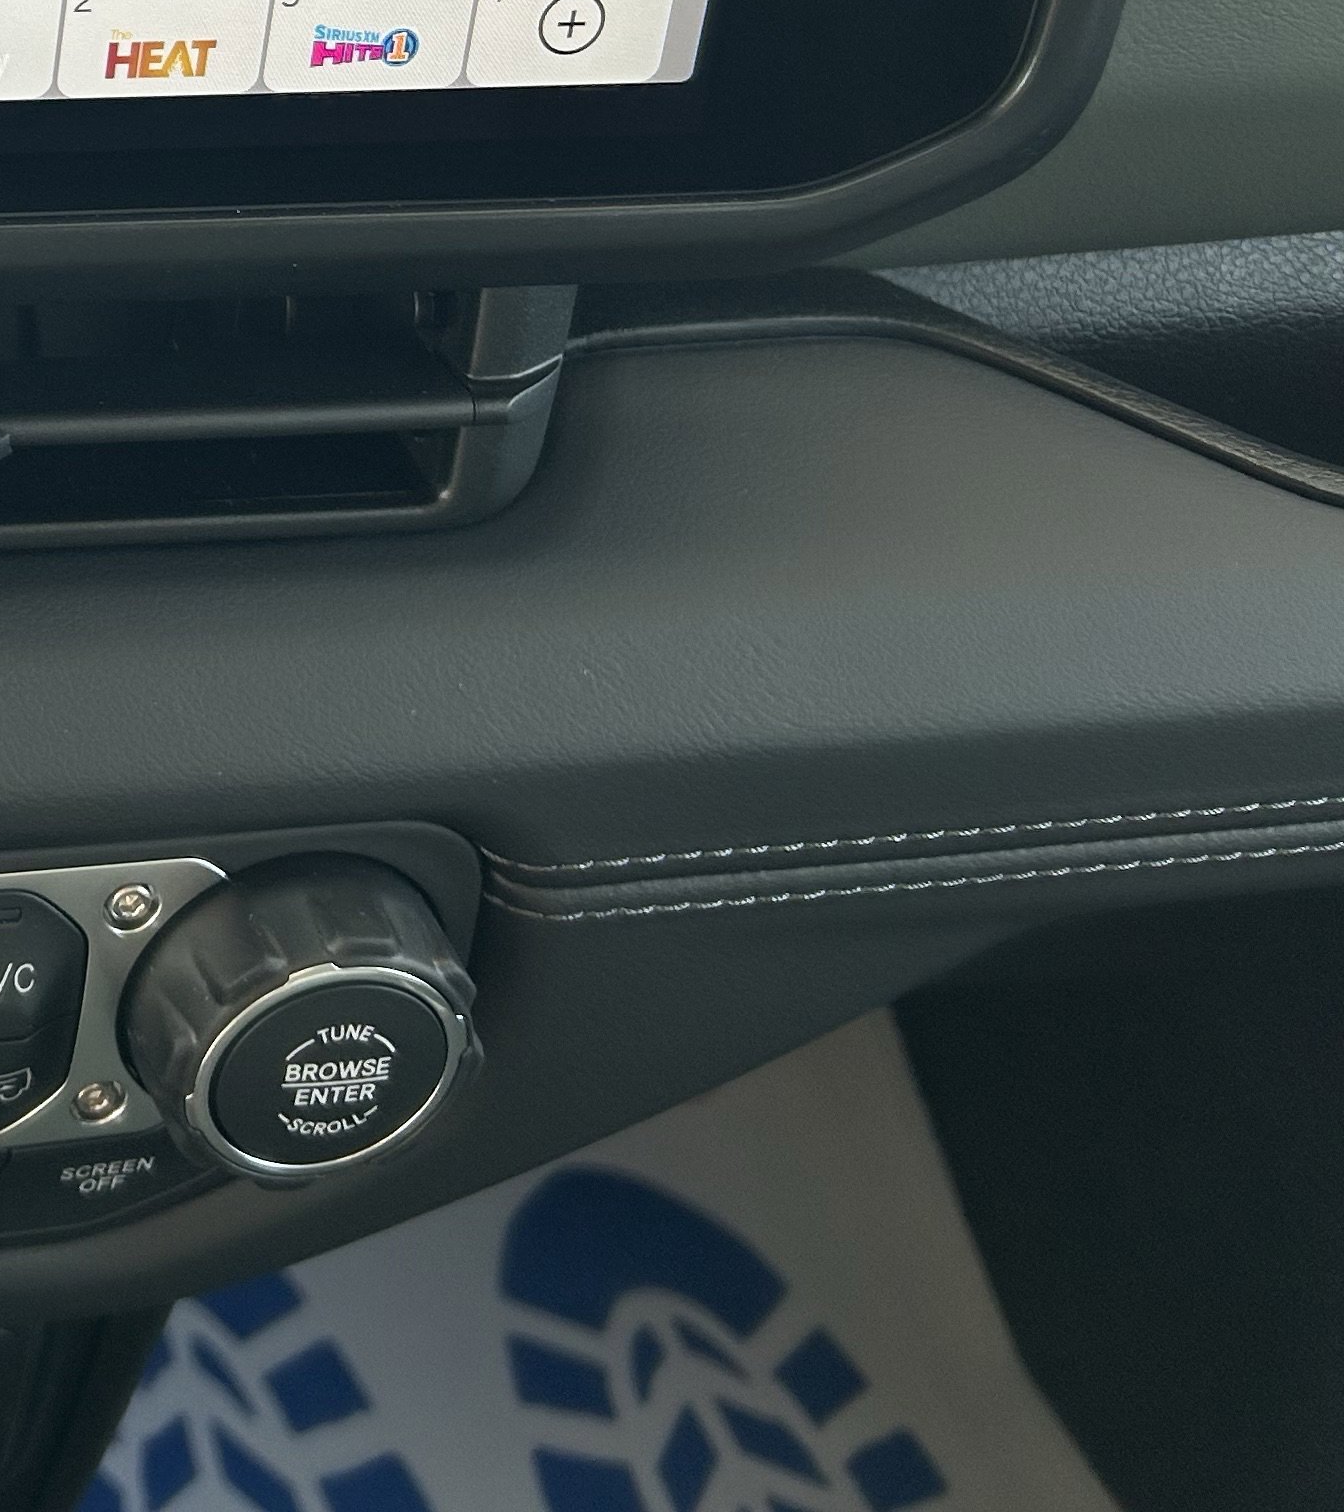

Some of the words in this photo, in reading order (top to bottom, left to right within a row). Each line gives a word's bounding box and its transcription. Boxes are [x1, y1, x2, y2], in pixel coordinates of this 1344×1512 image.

[105, 40, 217, 79] HEAT
[317, 1024, 375, 1044] TUNE
[284, 1057, 392, 1083] BROWSE
[294, 1084, 376, 1107] ENTER
[287, 1112, 368, 1136] SCROLL
[60, 1156, 154, 1182] SCREEN
[78, 1173, 126, 1194] OFF
